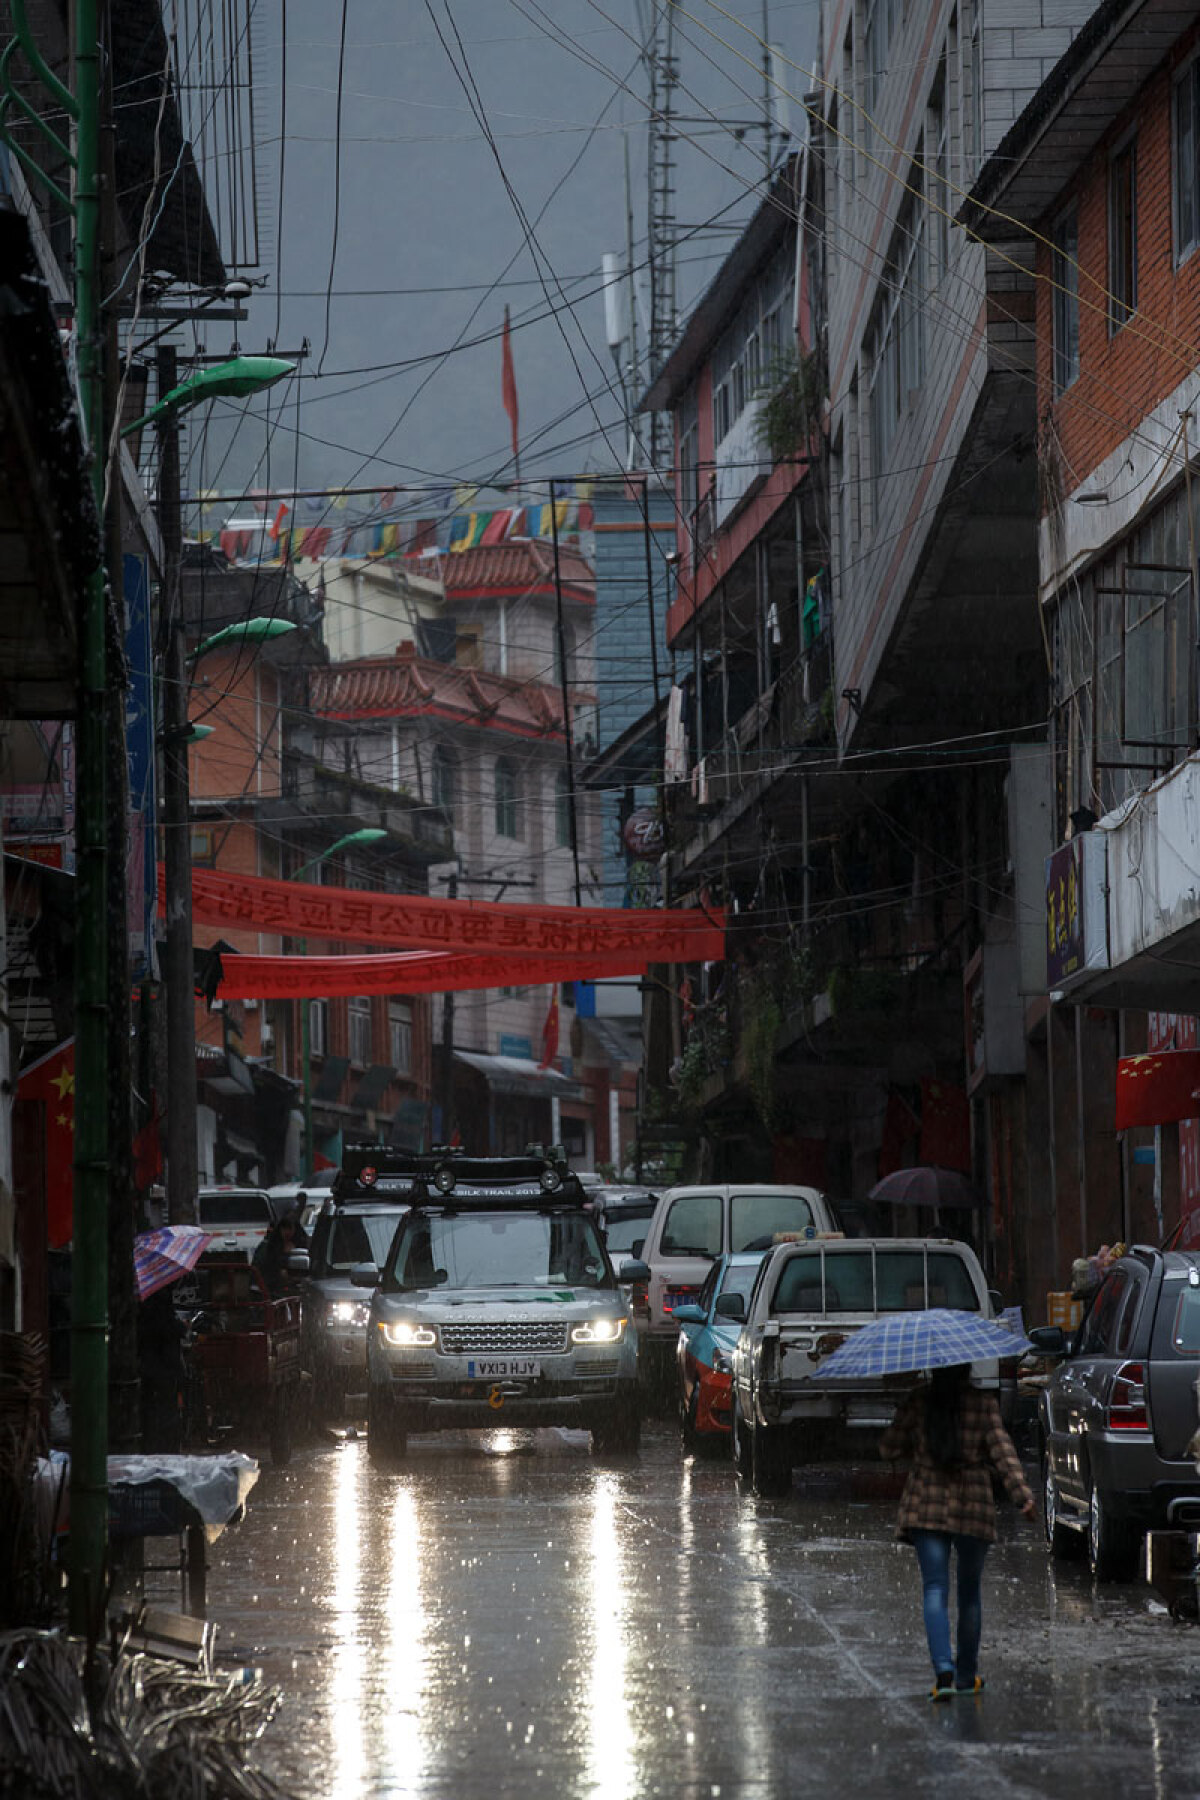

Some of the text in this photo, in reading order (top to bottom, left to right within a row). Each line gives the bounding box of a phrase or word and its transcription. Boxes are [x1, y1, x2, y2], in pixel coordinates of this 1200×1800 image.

[515, 1188, 541, 1196] 2013
[479, 1362, 536, 1375] VX13 HJY
